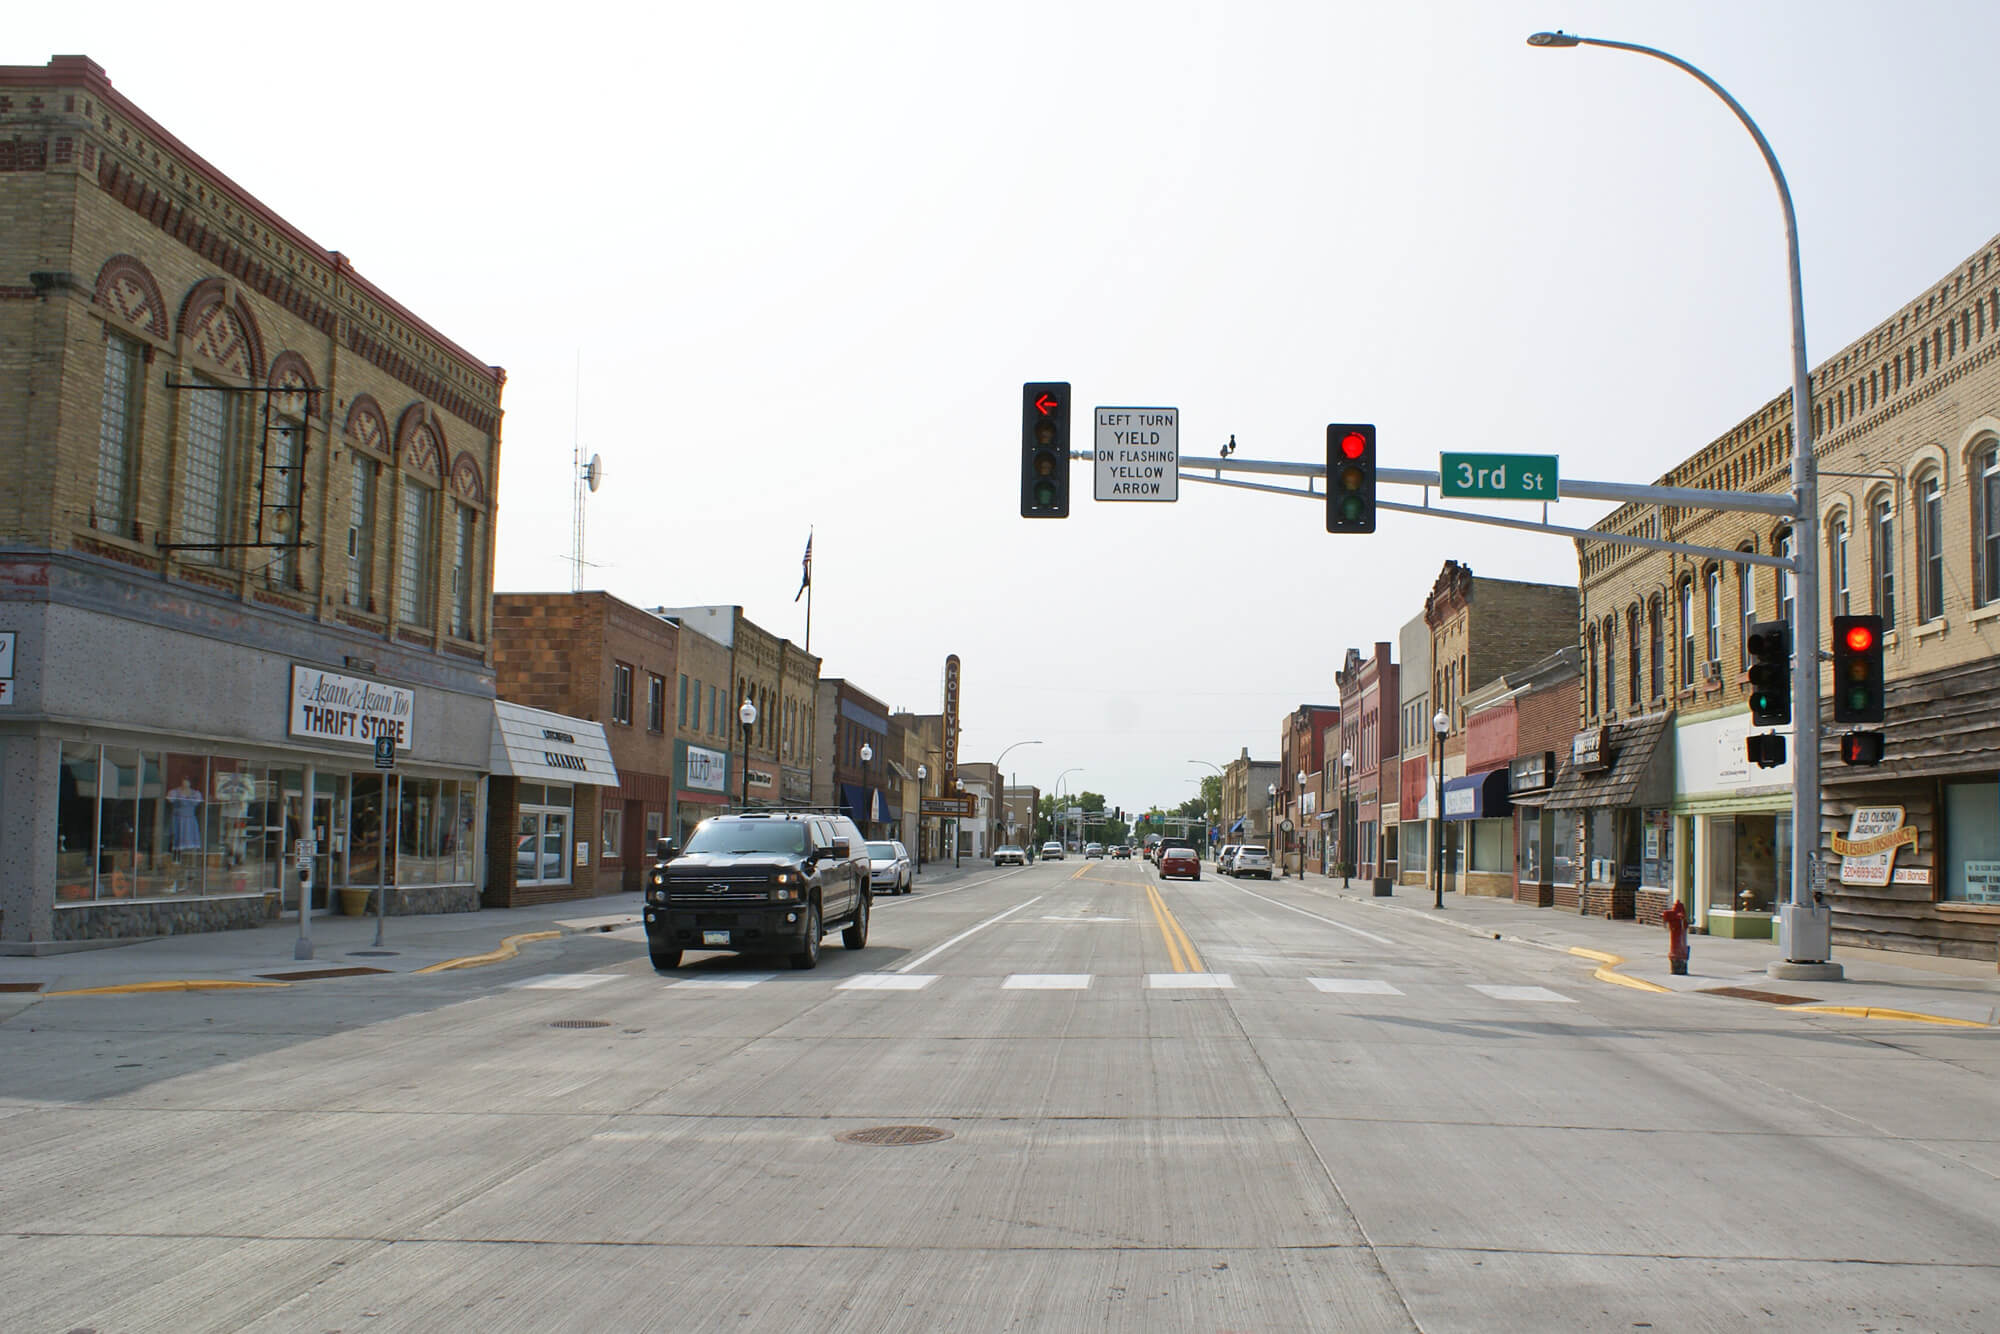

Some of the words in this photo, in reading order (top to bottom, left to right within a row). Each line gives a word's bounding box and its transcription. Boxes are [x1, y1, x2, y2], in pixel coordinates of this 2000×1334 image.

[1100, 414, 1131, 426] LEFT
[1139, 414, 1173, 426] TURN
[1114, 431, 1160, 445] YIELD
[1098, 450, 1114, 462] ON
[1120, 450, 1174, 462] FLASHING
[1110, 466, 1163, 478] YELLOW
[1456, 462, 1506, 489] 3rd
[1522, 472, 1544, 490] St
[1112, 482, 1160, 494] ARROW
[307, 673, 349, 707] Again
[355, 683, 393, 715] Again
[303, 704, 358, 737] THRIFT
[360, 714, 405, 744] STORE
[945, 671, 958, 771] HOLLYWOOD
[1858, 811, 1869, 823] ED
[1870, 811, 1898, 823] OLSON
